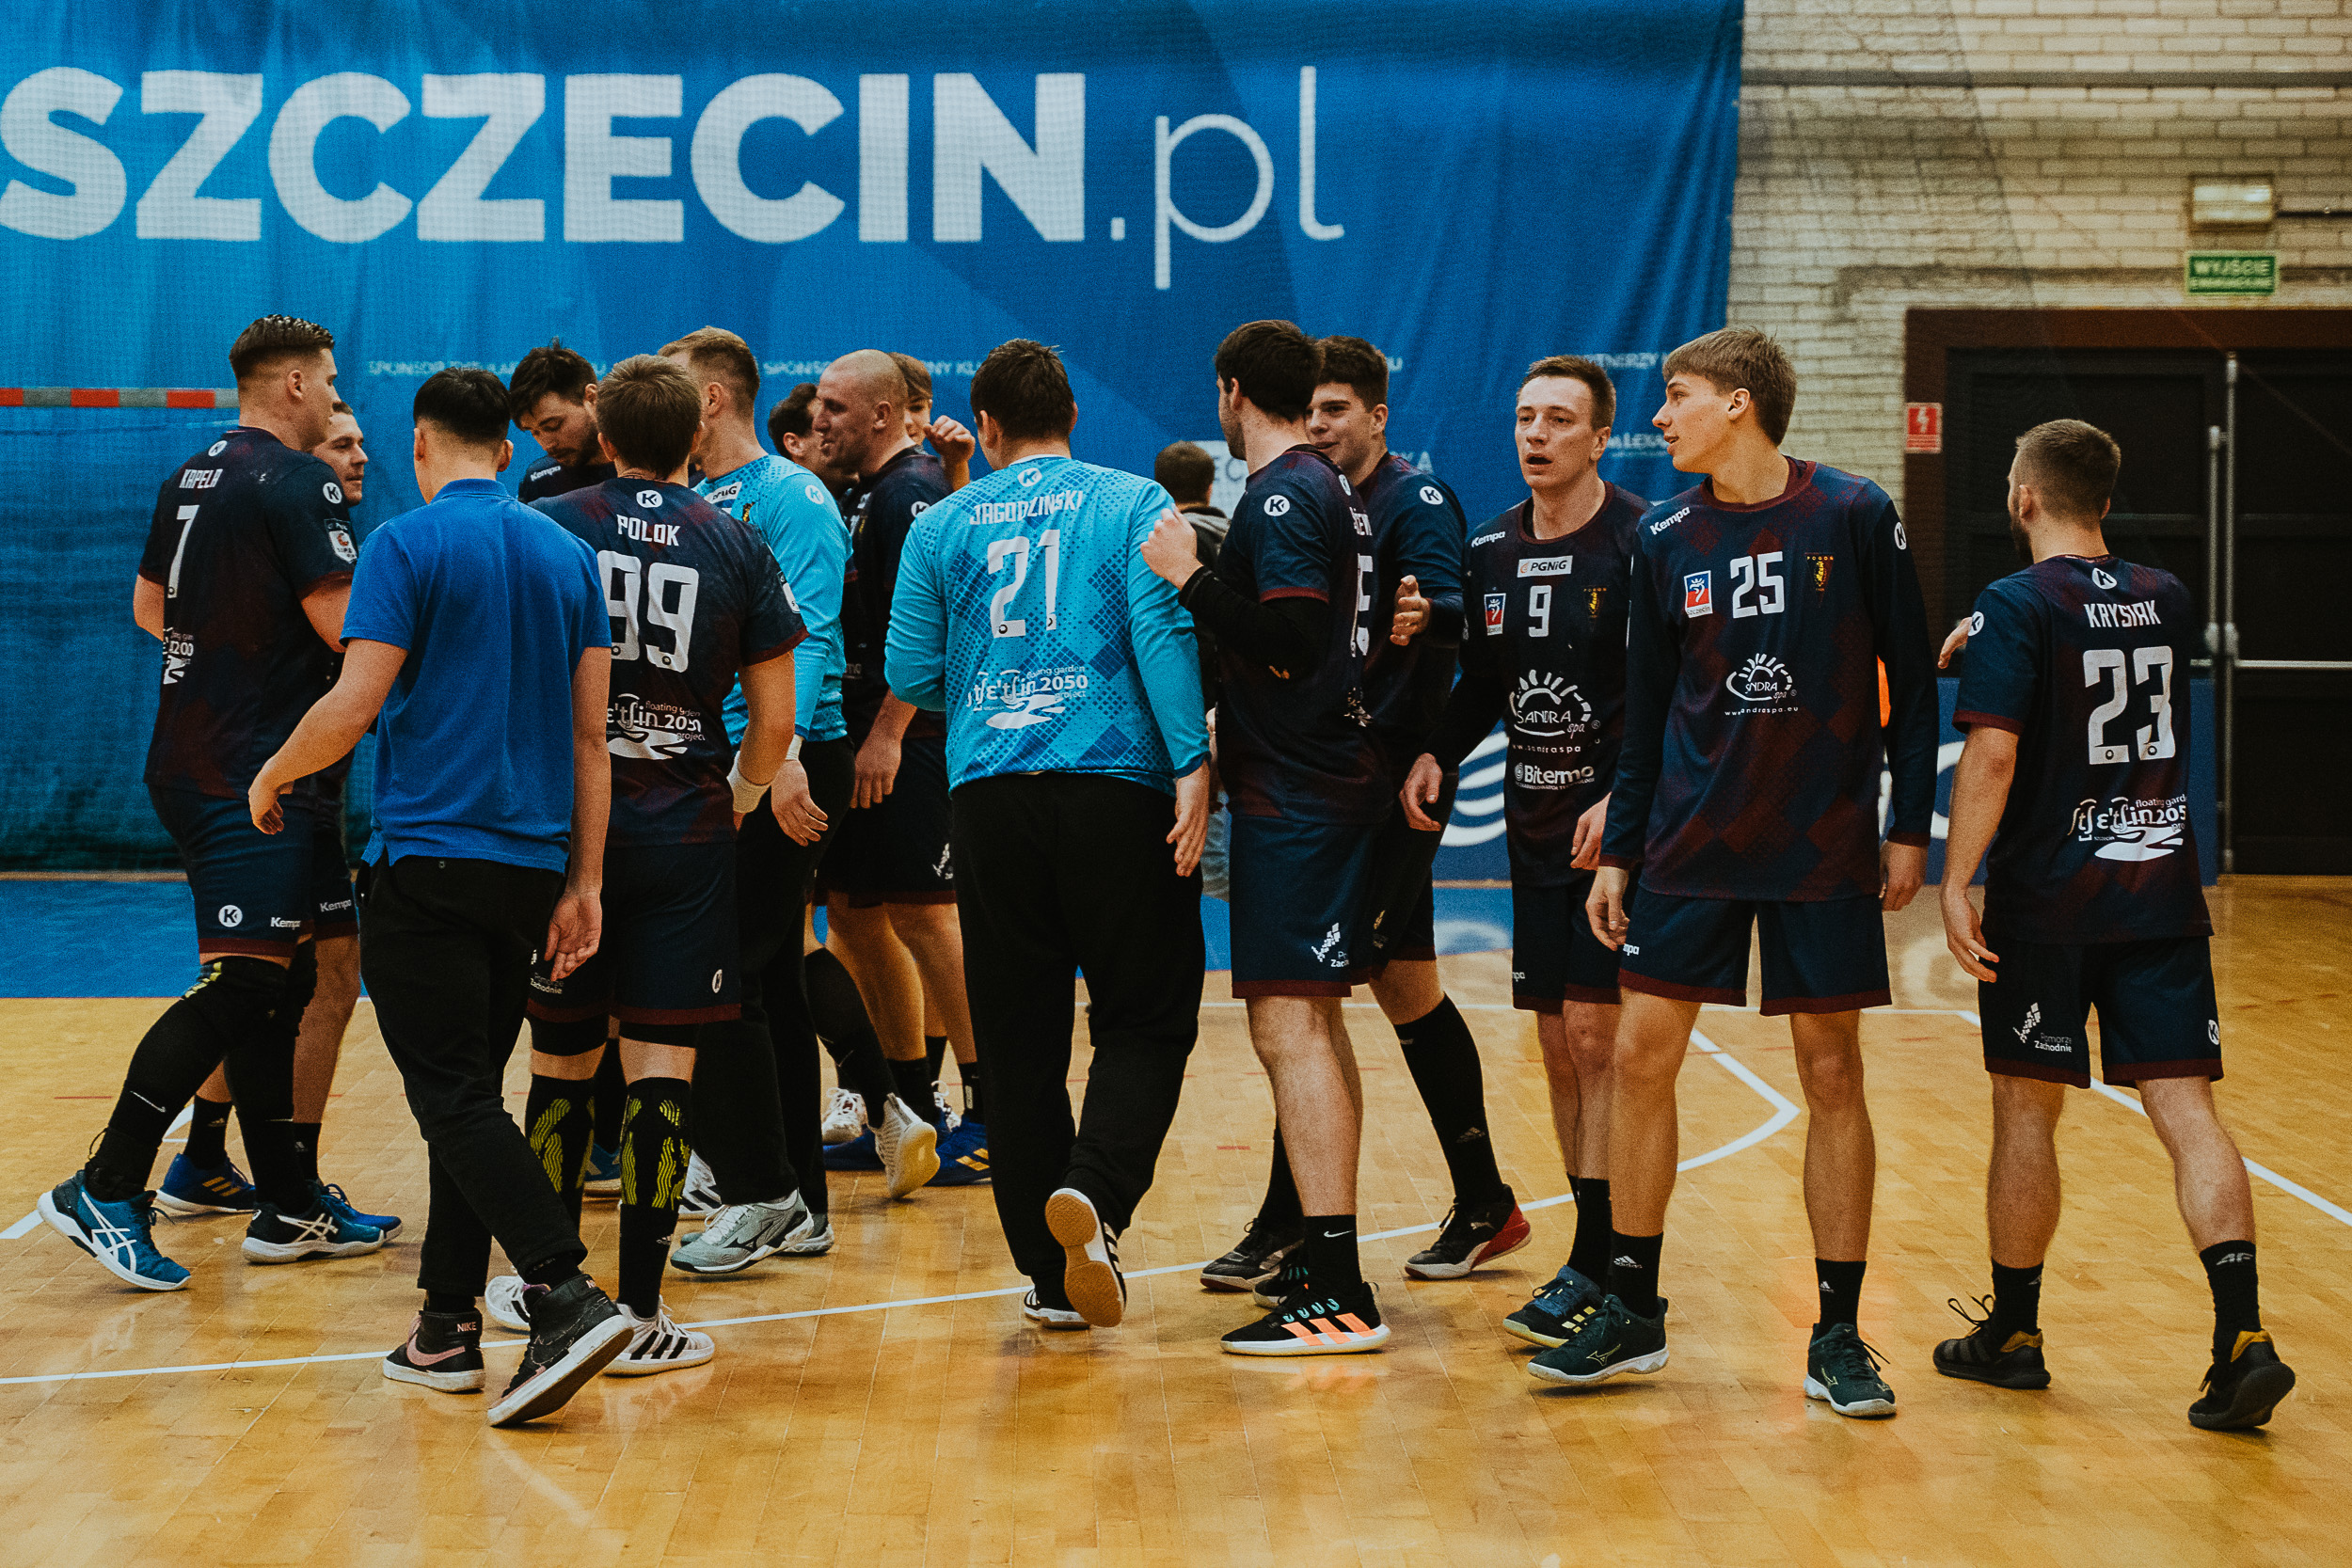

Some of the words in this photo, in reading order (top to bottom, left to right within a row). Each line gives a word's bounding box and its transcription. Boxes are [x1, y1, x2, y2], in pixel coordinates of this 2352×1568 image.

[179, 468, 223, 489] KAPELA
[530, 465, 562, 482] Kempa
[617, 515, 681, 546] POLOK
[1649, 506, 1691, 536] Kempa
[167, 504, 199, 599] 7
[1471, 531, 1506, 548] Kempa
[1530, 560, 1567, 572] PGNiG
[988, 529, 1061, 639] 21
[1730, 550, 1786, 619] 25
[596, 550, 700, 673] 99
[1528, 585, 1552, 638] 9
[2083, 600, 2162, 628] KRYSIAK
[1040, 674, 1089, 692] 2050
[1517, 709, 1571, 724] SANDRA
[2082, 645, 2177, 766] 23
[1566, 722, 1585, 740] spa
[456, 1321, 477, 1333] NIKE
